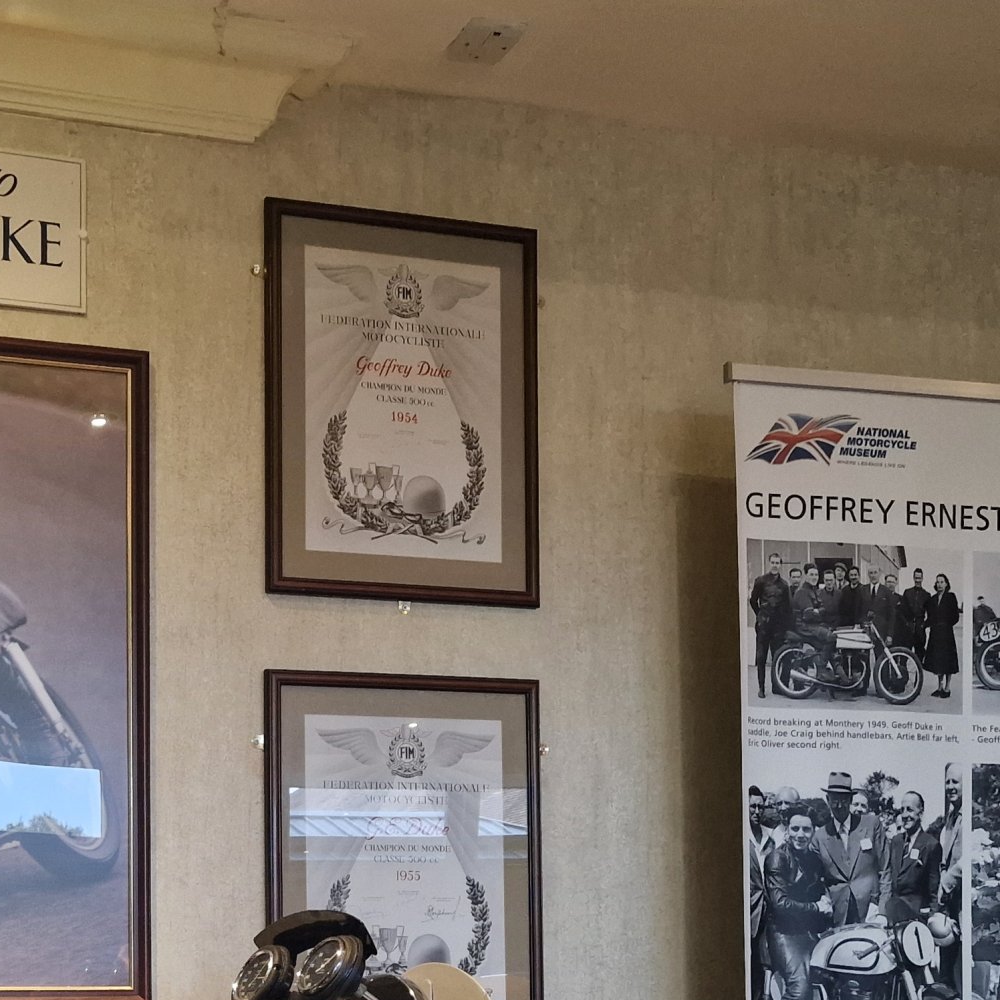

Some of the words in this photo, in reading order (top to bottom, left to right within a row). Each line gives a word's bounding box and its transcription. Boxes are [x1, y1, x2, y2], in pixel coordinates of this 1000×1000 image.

[362, 332, 445, 349] MOTOCYCLISTE
[356, 356, 412, 378] Geoffrey
[417, 361, 452, 378] Duke
[361, 382, 401, 392] CHAMPION
[418, 387, 447, 395] MONDE
[391, 412, 418, 424] 1954
[857, 427, 911, 439] NATIONAL
[847, 437, 918, 450] MOTORCYCLE
[839, 447, 887, 458] MUSEUM
[746, 492, 895, 524] GEOFFREY
[906, 500, 1000, 531] ERNEST
[748, 716, 771, 725] Record
[773, 717, 811, 728] breaking
[814, 719, 822, 727] at
[826, 719, 864, 729] Monthery
[891, 721, 913, 729] Geoff
[915, 722, 933, 731] Duke
[936, 723, 943, 731] in
[972, 724, 987, 732] The
[774, 730, 788, 738] Joe
[791, 730, 813, 739] Craig
[816, 730, 845, 739] behind
[917, 733, 930, 741] Bell
[932, 734, 942, 742] far
[761, 739, 784, 748] Oliver
[787, 741, 817, 749] second
[400, 746, 415, 759] FIM
[364, 844, 406, 852] CHAMPION
[421, 845, 450, 853] MONDE
[373, 855, 405, 863] CLASSE
[396, 870, 421, 881] 1955
